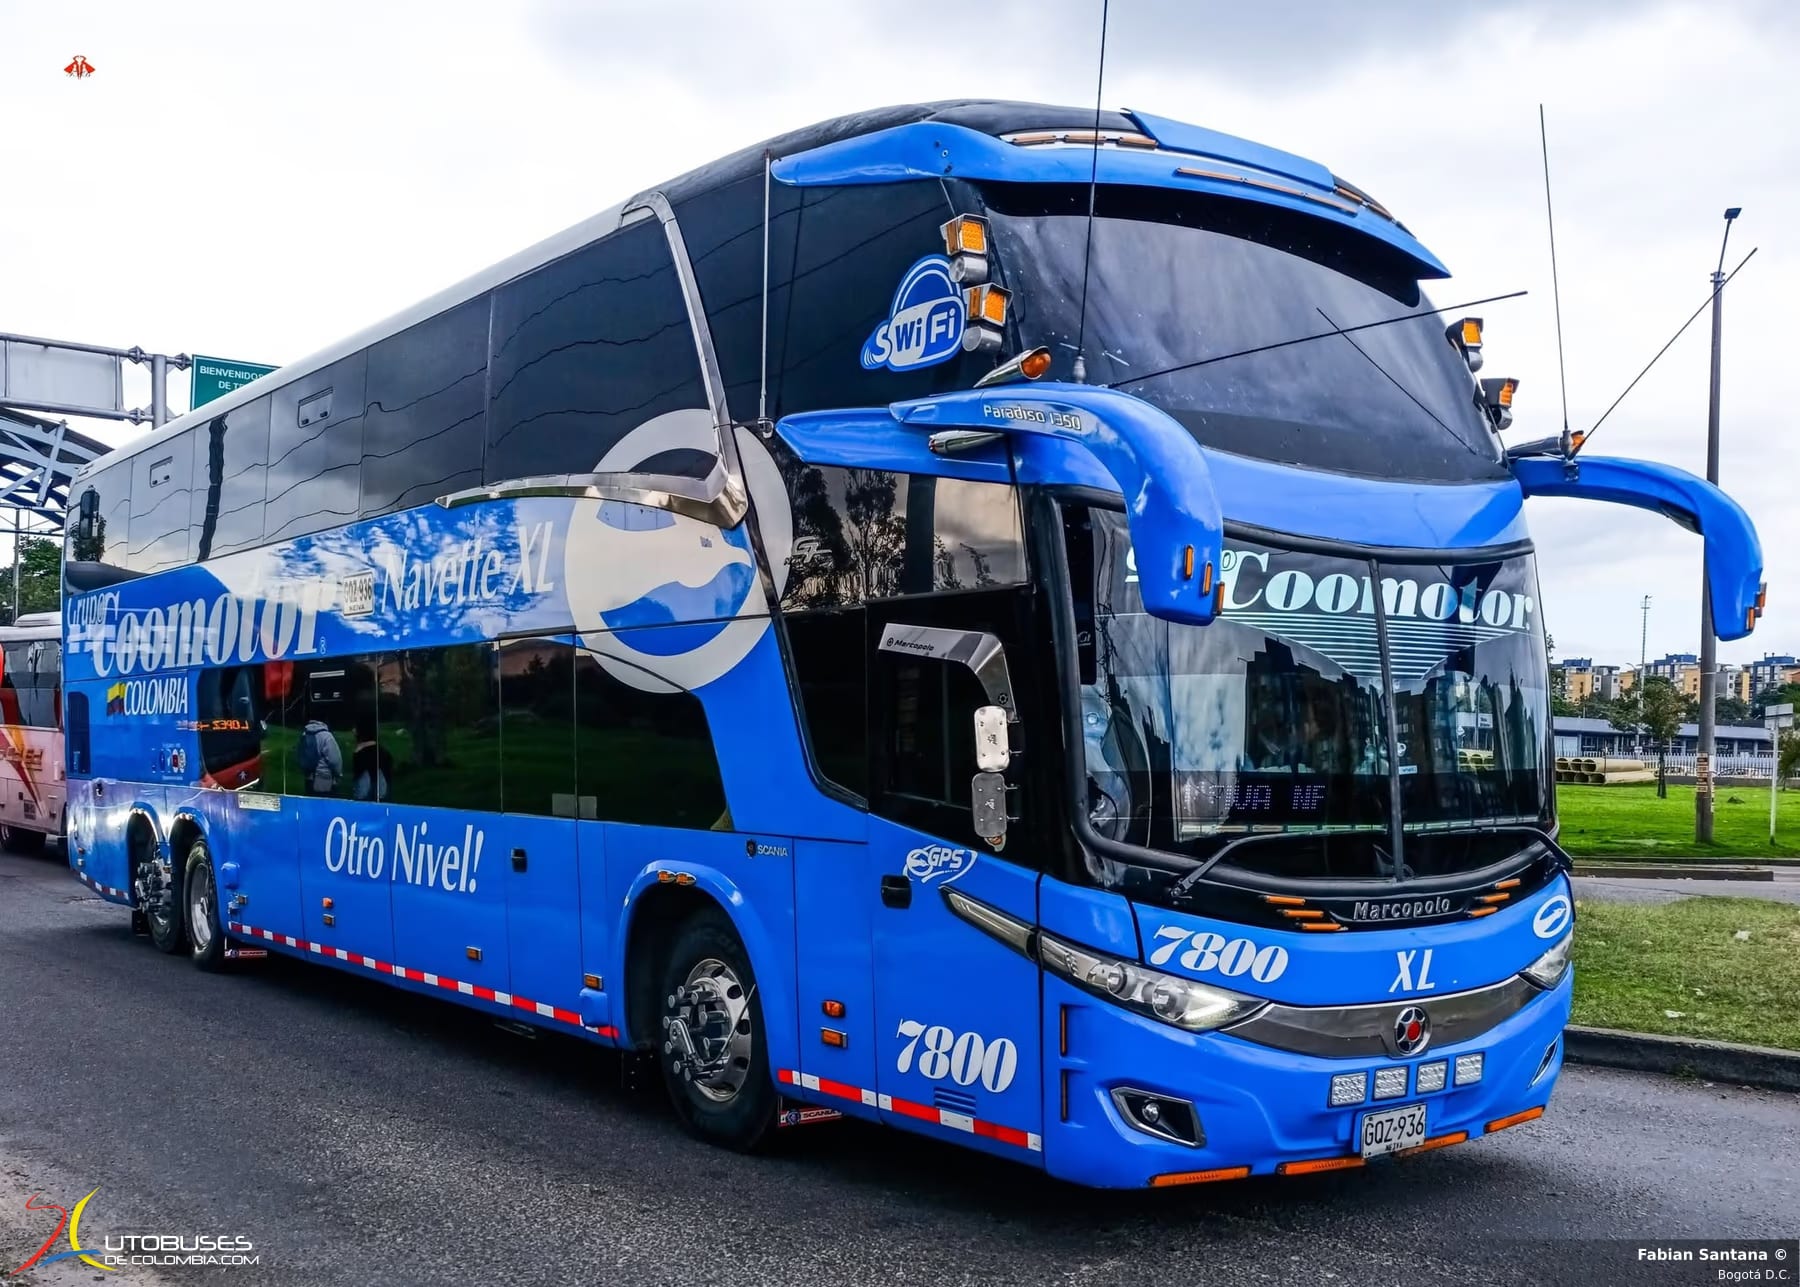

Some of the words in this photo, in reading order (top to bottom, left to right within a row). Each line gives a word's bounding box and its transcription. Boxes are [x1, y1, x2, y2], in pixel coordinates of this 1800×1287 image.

[218, 381, 231, 390] DE
[983, 404, 1046, 424] Paradiso
[1050, 414, 1082, 431] 1350
[381, 537, 501, 613] Navette
[509, 521, 554, 595] XL
[1221, 550, 1534, 630] Coomotor
[92, 577, 330, 678] Coomotor
[894, 639, 935, 652] Marcopolo
[124, 677, 188, 716] COLOMBIA
[325, 816, 384, 878] Otro
[392, 821, 484, 893] Nivel!
[757, 844, 788, 857] SCANIA
[1353, 897, 1450, 920] Marcopolo
[1150, 924, 1289, 983] 7800
[1389, 949, 1435, 992] XL
[896, 1018, 1018, 1093] 7800
